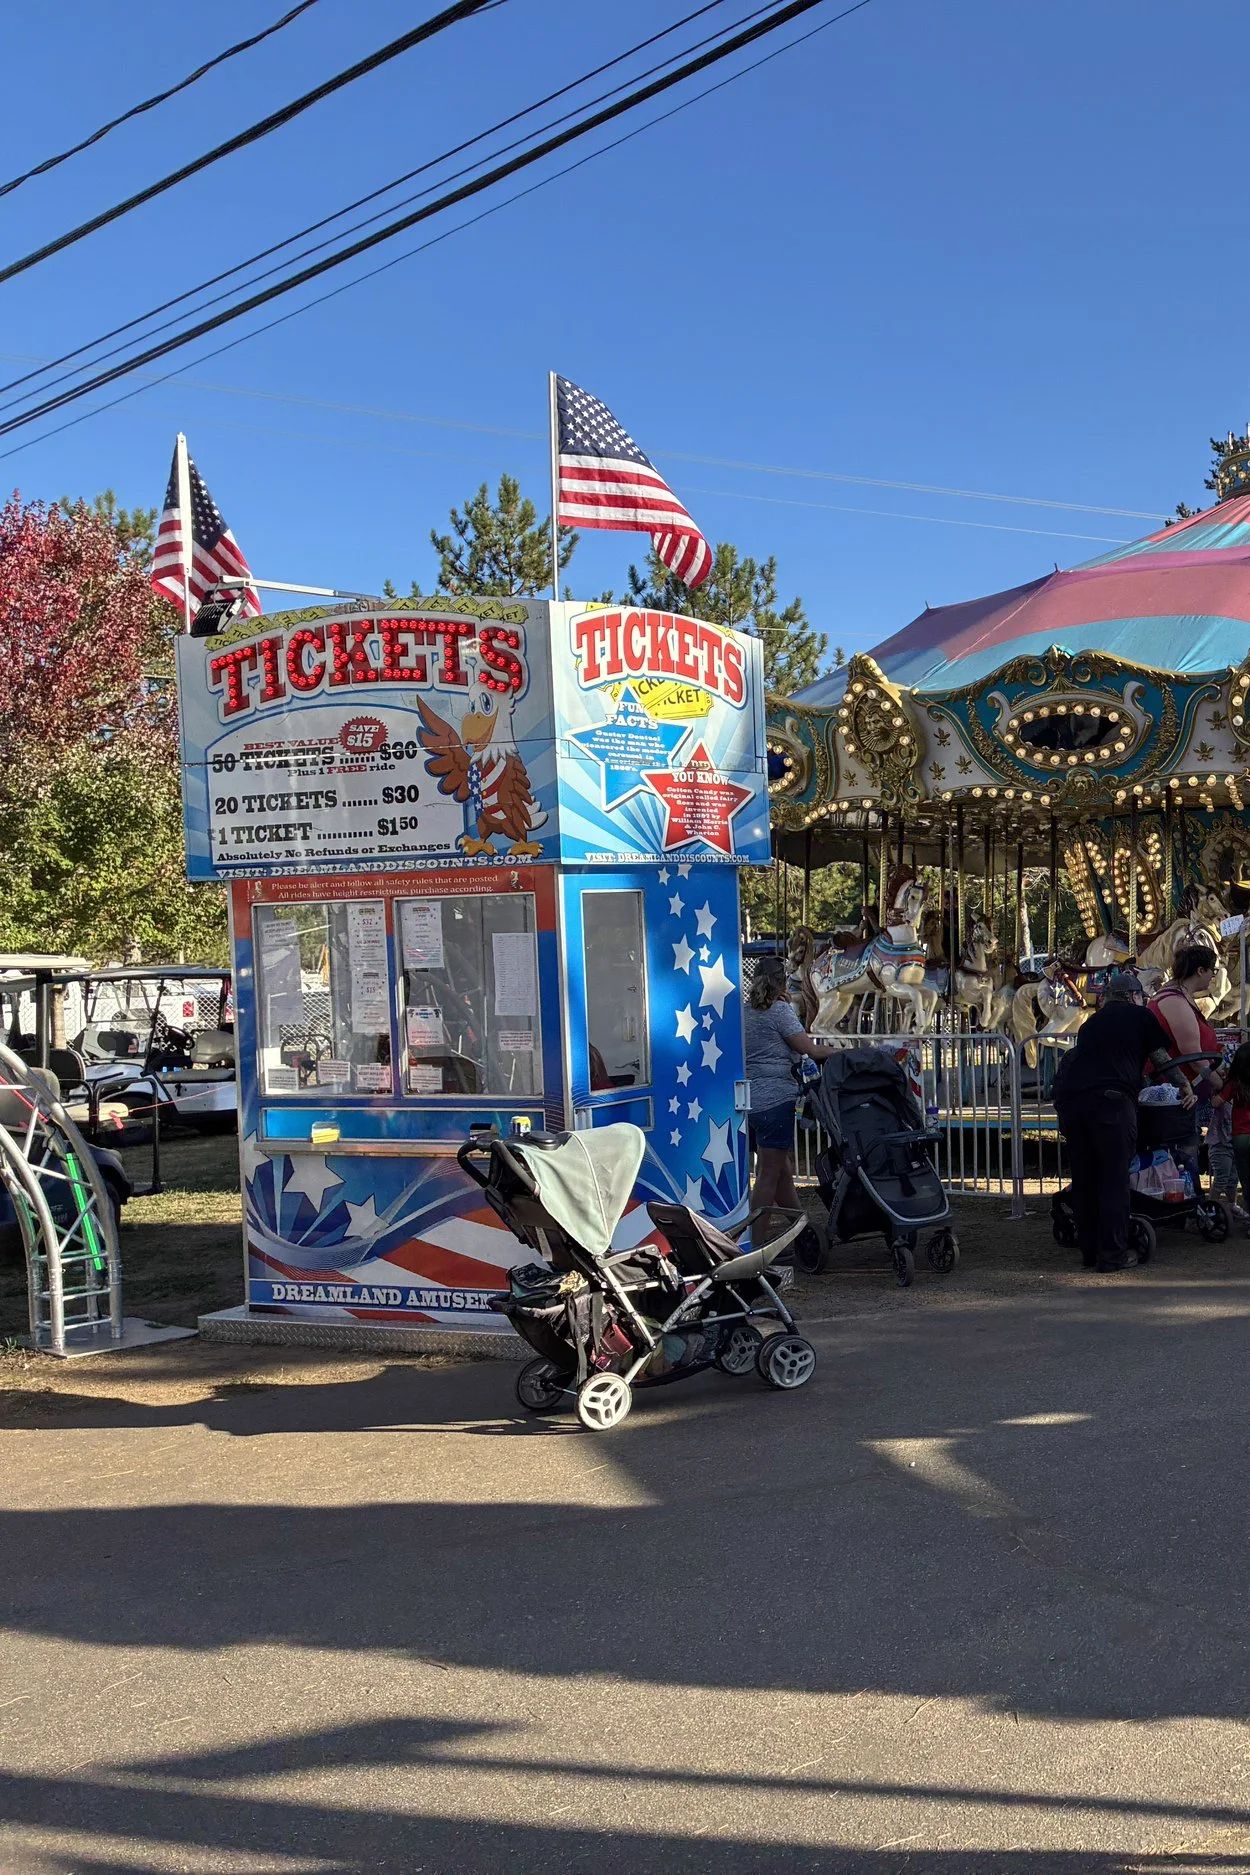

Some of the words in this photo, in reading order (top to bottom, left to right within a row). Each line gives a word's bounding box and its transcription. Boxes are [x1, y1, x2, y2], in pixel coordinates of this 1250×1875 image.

[576, 612, 743, 703] TICKETS
[211, 617, 523, 717] TICKETS
[617, 702, 645, 714] FUN
[348, 724, 379, 733] SAVE
[605, 713, 659, 730] FACTS
[243, 741, 286, 751] BEST
[288, 737, 339, 748] VALUE
[346, 732, 374, 747] $15
[212, 752, 236, 773] 50
[239, 745, 335, 771] TICKETS
[379, 740, 418, 761] $60
[287, 767, 317, 778] Plus
[318, 766, 325, 776] 1
[326, 763, 368, 775] FREE
[369, 762, 396, 773] ride
[672, 771, 695, 783] YOU
[696, 771, 730, 786] KNOW
[215, 796, 239, 815] 20
[242, 789, 338, 814] TICKETS
[382, 784, 419, 805] $30
[666, 786, 693, 794] Cotton
[693, 788, 718, 796] Candy
[218, 826, 228, 845] 1
[230, 821, 313, 845] TICKET
[217, 849, 282, 862] Absolutely
[284, 848, 302, 858] No
[304, 846, 358, 857] Refunds
[361, 846, 376, 854] or
[377, 842, 451, 854] Exchanges
[617, 852, 749, 864] DREAMLANDDISCOUNTS.COM
[216, 867, 268, 880] VISIT:
[270, 853, 534, 877] DREAMLANDDISCOUNTS.COM
[271, 883, 297, 891] Please
[298, 882, 308, 890] be
[309, 880, 328, 889] alert
[329, 880, 346, 888] and
[347, 879, 372, 888] follow
[373, 879, 384, 887] all
[386, 877, 411, 887] safety
[412, 876, 433, 885] rules
[434, 876, 452, 885] that
[469, 874, 499, 885] posted
[278, 891, 289, 900] All
[290, 891, 311, 900] rides
[312, 890, 332, 899] have
[333, 888, 359, 899] height
[410, 884, 449, 896] purchase
[271, 1283, 402, 1307] DREAMLAND
